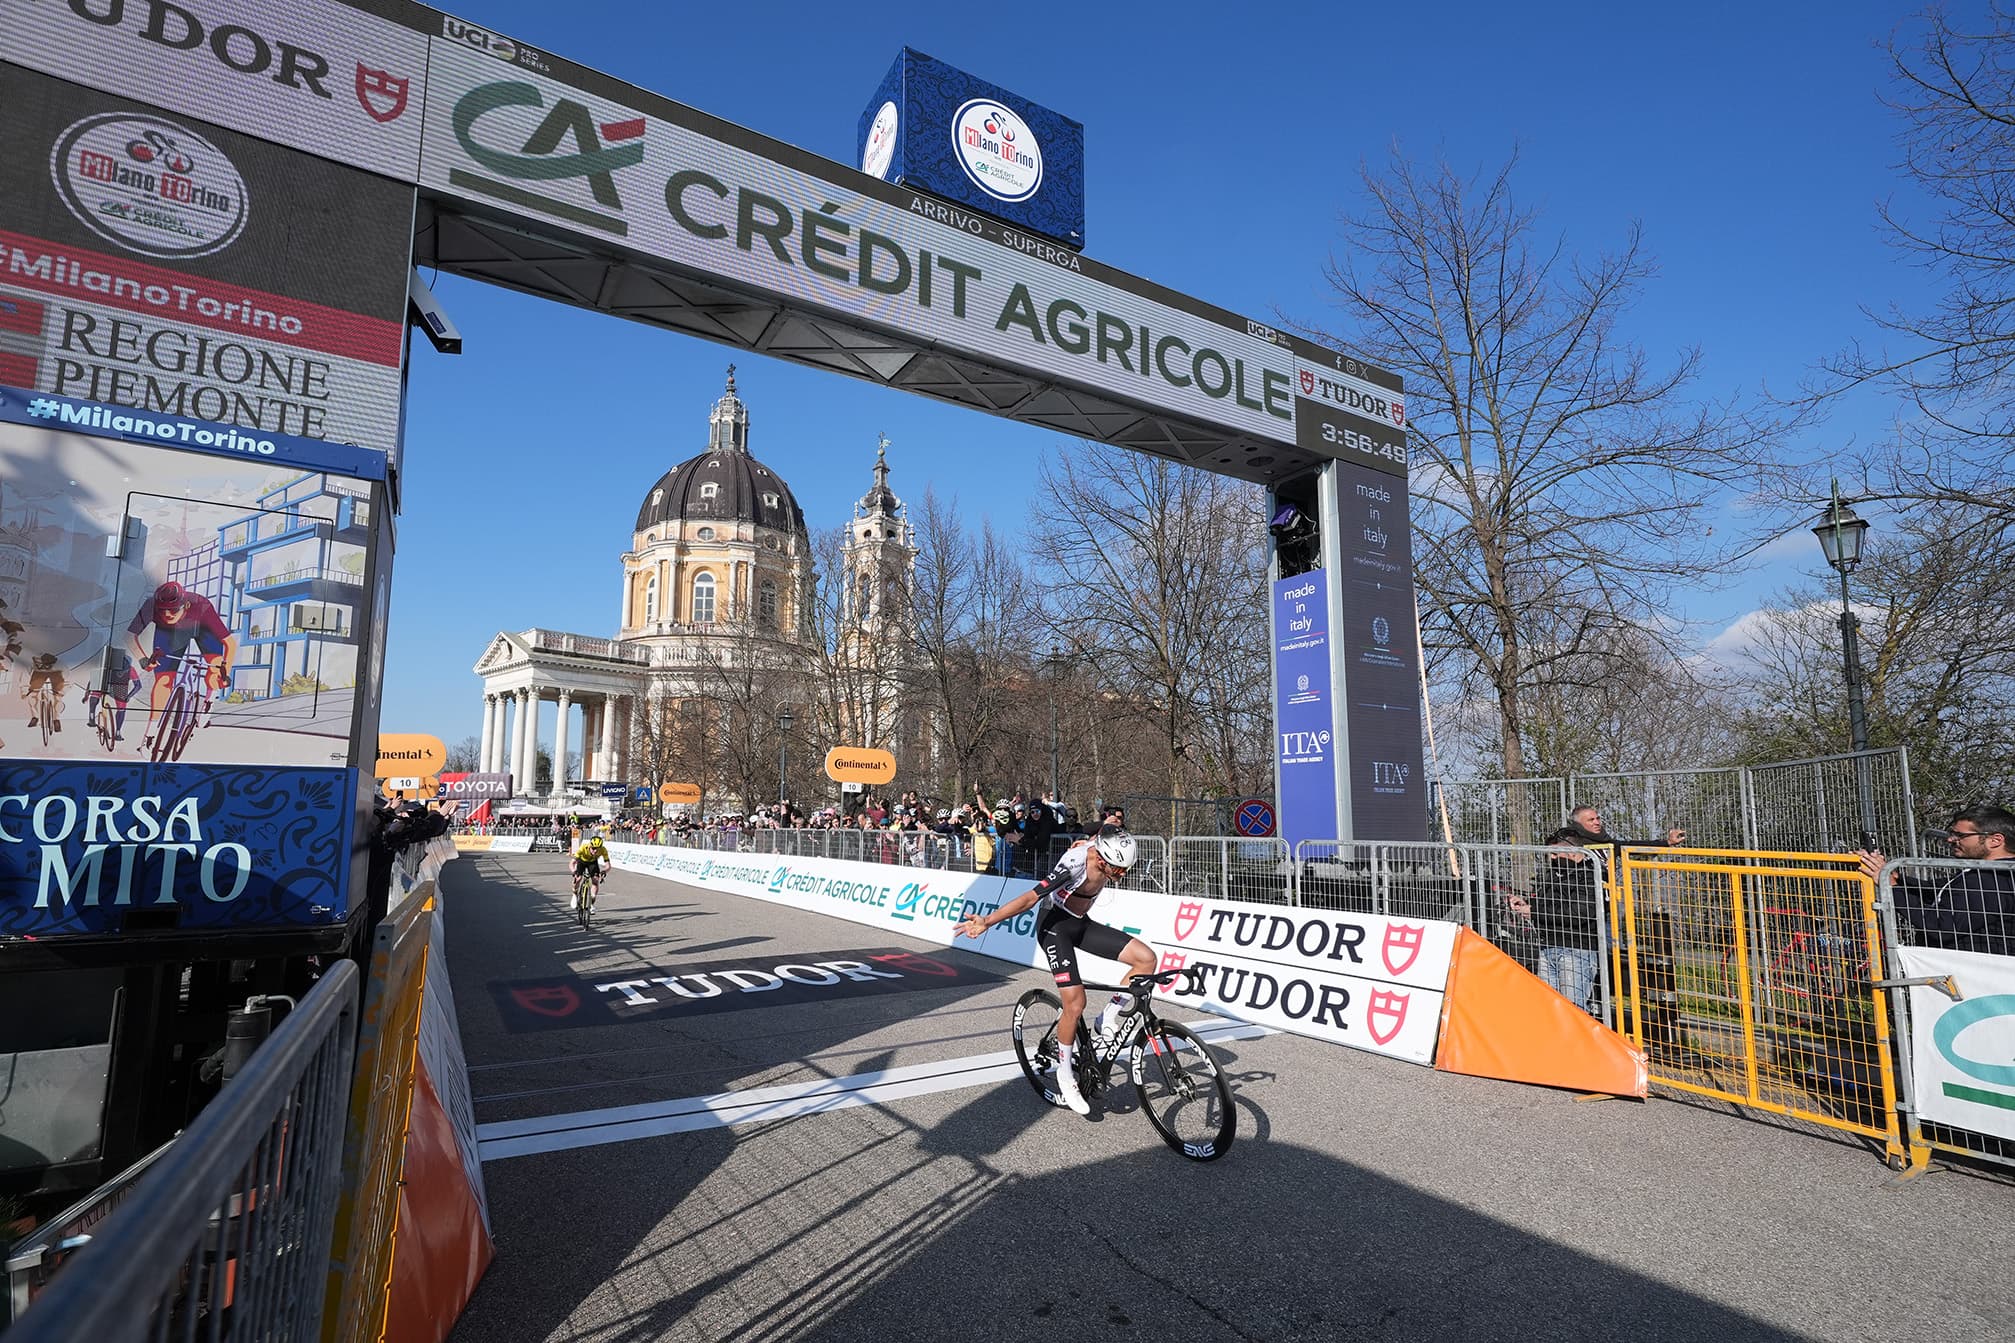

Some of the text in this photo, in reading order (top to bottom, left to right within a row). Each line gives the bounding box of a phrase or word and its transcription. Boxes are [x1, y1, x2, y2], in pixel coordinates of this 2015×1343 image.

[66, 0, 333, 99] UDOR
[447, 20, 489, 50] UCI
[520, 55, 550, 72] SERIES
[910, 196, 983, 235] ARRIVO
[1002, 230, 1082, 272] SUPERGA
[0, 244, 303, 335] MilanoTorino
[664, 169, 1293, 422] CRÉDIT AGRICOLE
[1248, 322, 1266, 338] UCI
[55, 307, 331, 401] REGIONE
[51, 357, 328, 440] PIEMONTE
[1318, 376, 1389, 419] TUDOR
[27, 397, 276, 456] #MilanoTorino
[1321, 422, 1407, 465] 3:56:49
[1356, 482, 1391, 503] made
[1369, 504, 1380, 521] in
[1363, 525, 1388, 549] italy
[1284, 582, 1316, 601] made
[1295, 602, 1306, 614] in
[1290, 616, 1313, 632] italy
[1281, 731, 1323, 756] ITA
[834, 758, 881, 771] Continental
[1372, 761, 1404, 785] ITA
[399, 778, 412, 787] 10
[445, 781, 507, 793] TOYOTA
[0, 794, 203, 843] CORSA
[33, 842, 252, 908] MITO
[732, 866, 770, 884] AGRICOLE
[786, 868, 828, 895] CRÉDIT
[822, 877, 890, 907] AGRICOLE
[1208, 908, 1366, 964] TUDOR
[1046, 944, 1060, 970] UAE
[593, 959, 904, 1008] TUDOR
[1192, 960, 1351, 1031] TUDOR
[1106, 1016, 1135, 1061] COLNAGO
